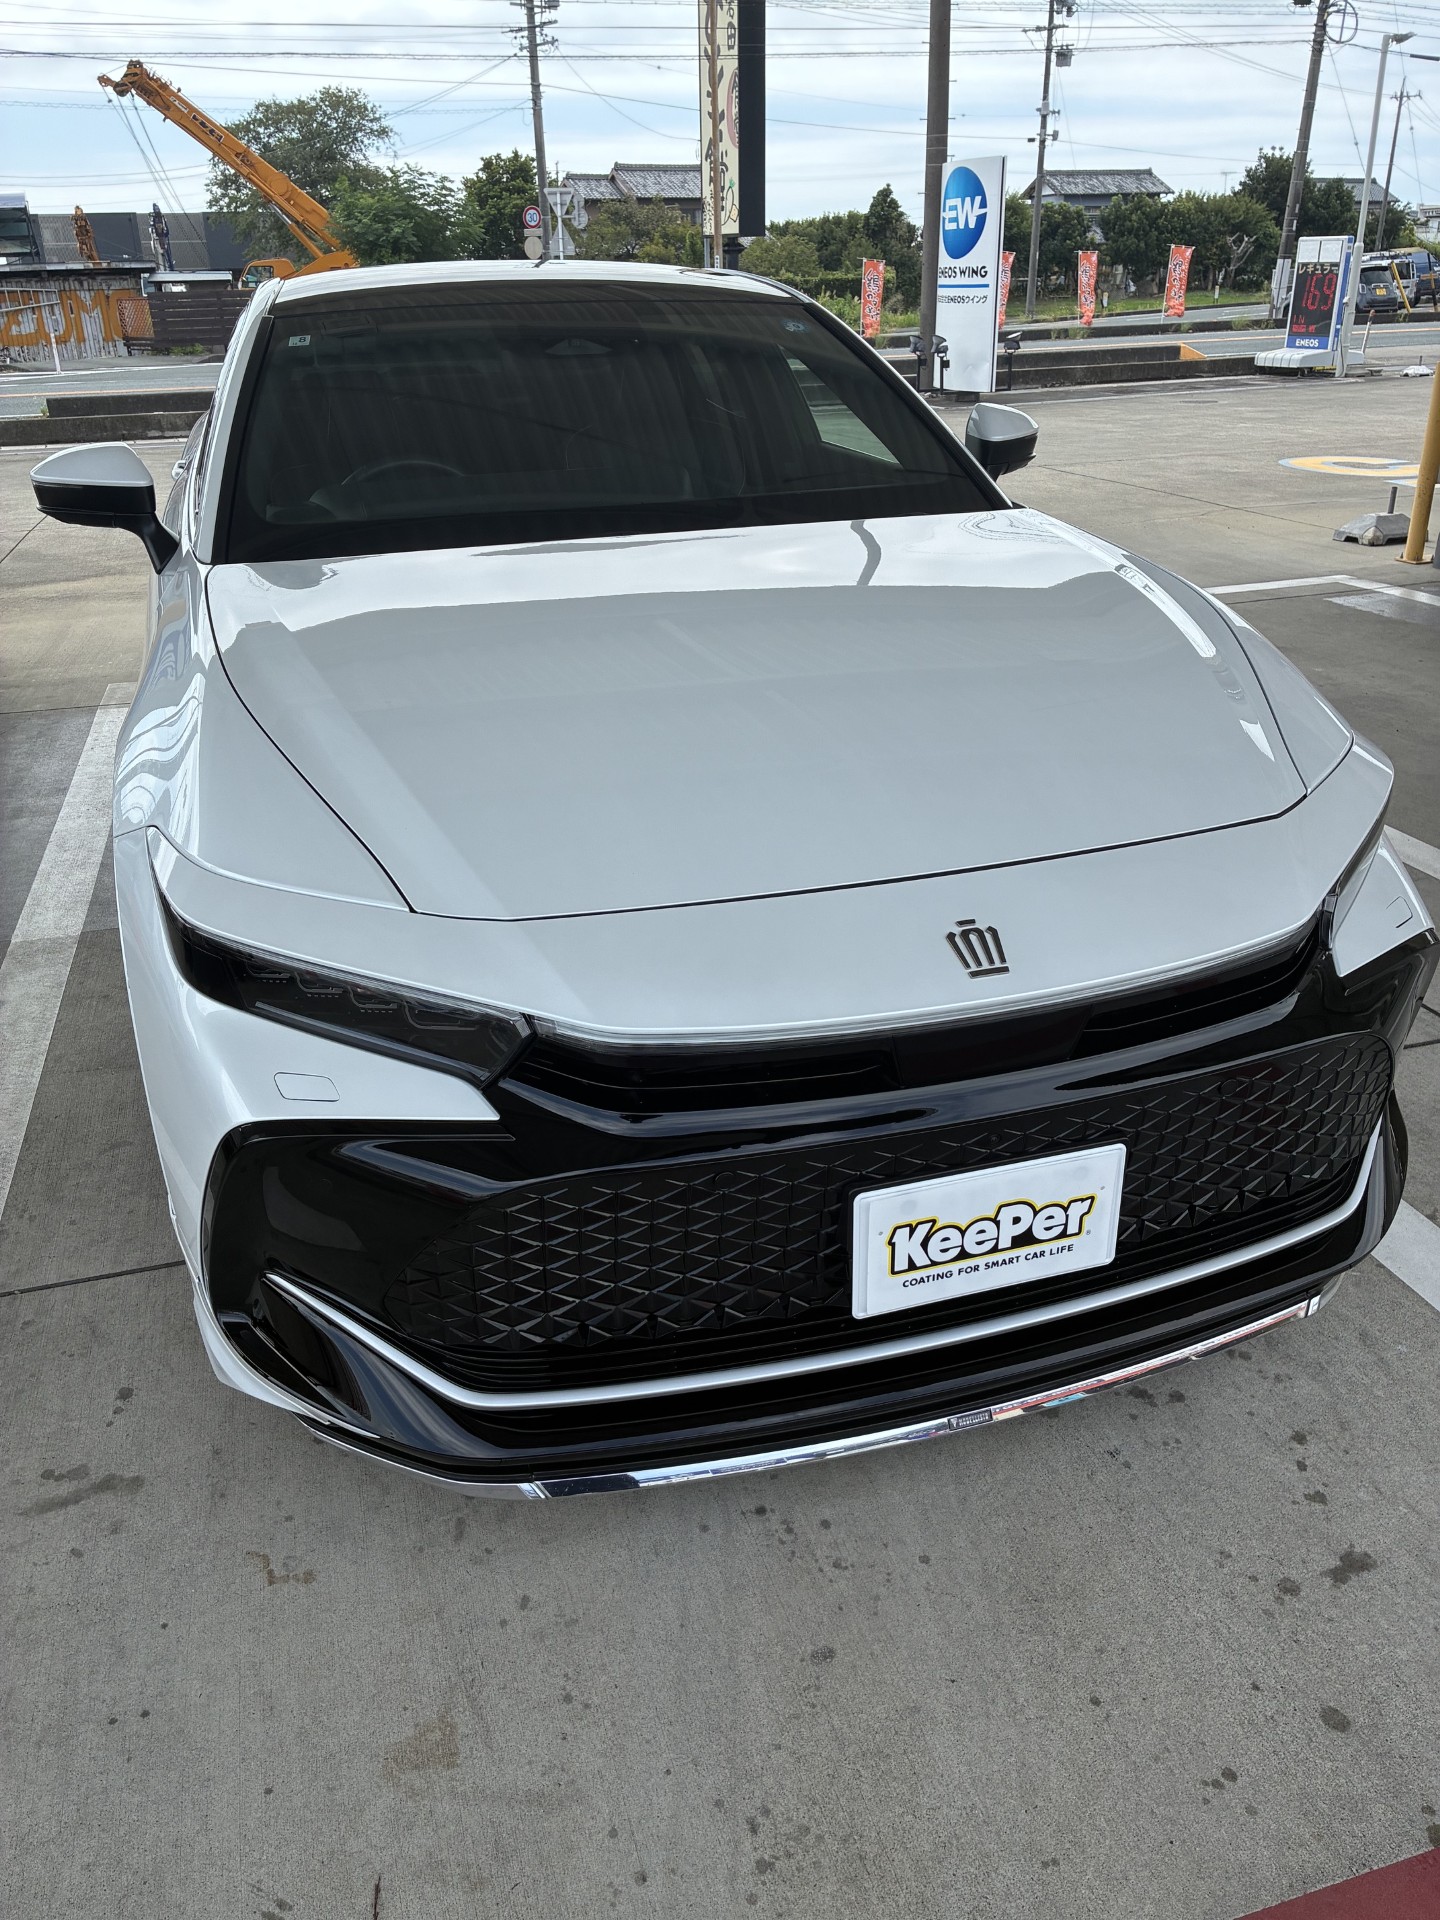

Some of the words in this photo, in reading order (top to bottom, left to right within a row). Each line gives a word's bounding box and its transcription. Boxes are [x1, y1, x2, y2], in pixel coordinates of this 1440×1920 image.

[527, 212, 538, 223] 30
[943, 195, 987, 230] EW
[958, 265, 988, 279] WING
[1298, 263, 1339, 274] レギュラー
[1301, 273, 1337, 310] 169
[1295, 337, 1319, 347] ENEOS
[888, 1196, 1095, 1275] KeePer
[902, 1270, 954, 1288] COATING
[957, 1263, 980, 1276] FOR
[984, 1255, 1021, 1270] SMART
[1024, 1250, 1046, 1261] CAR
[1049, 1243, 1075, 1256] LIFE
